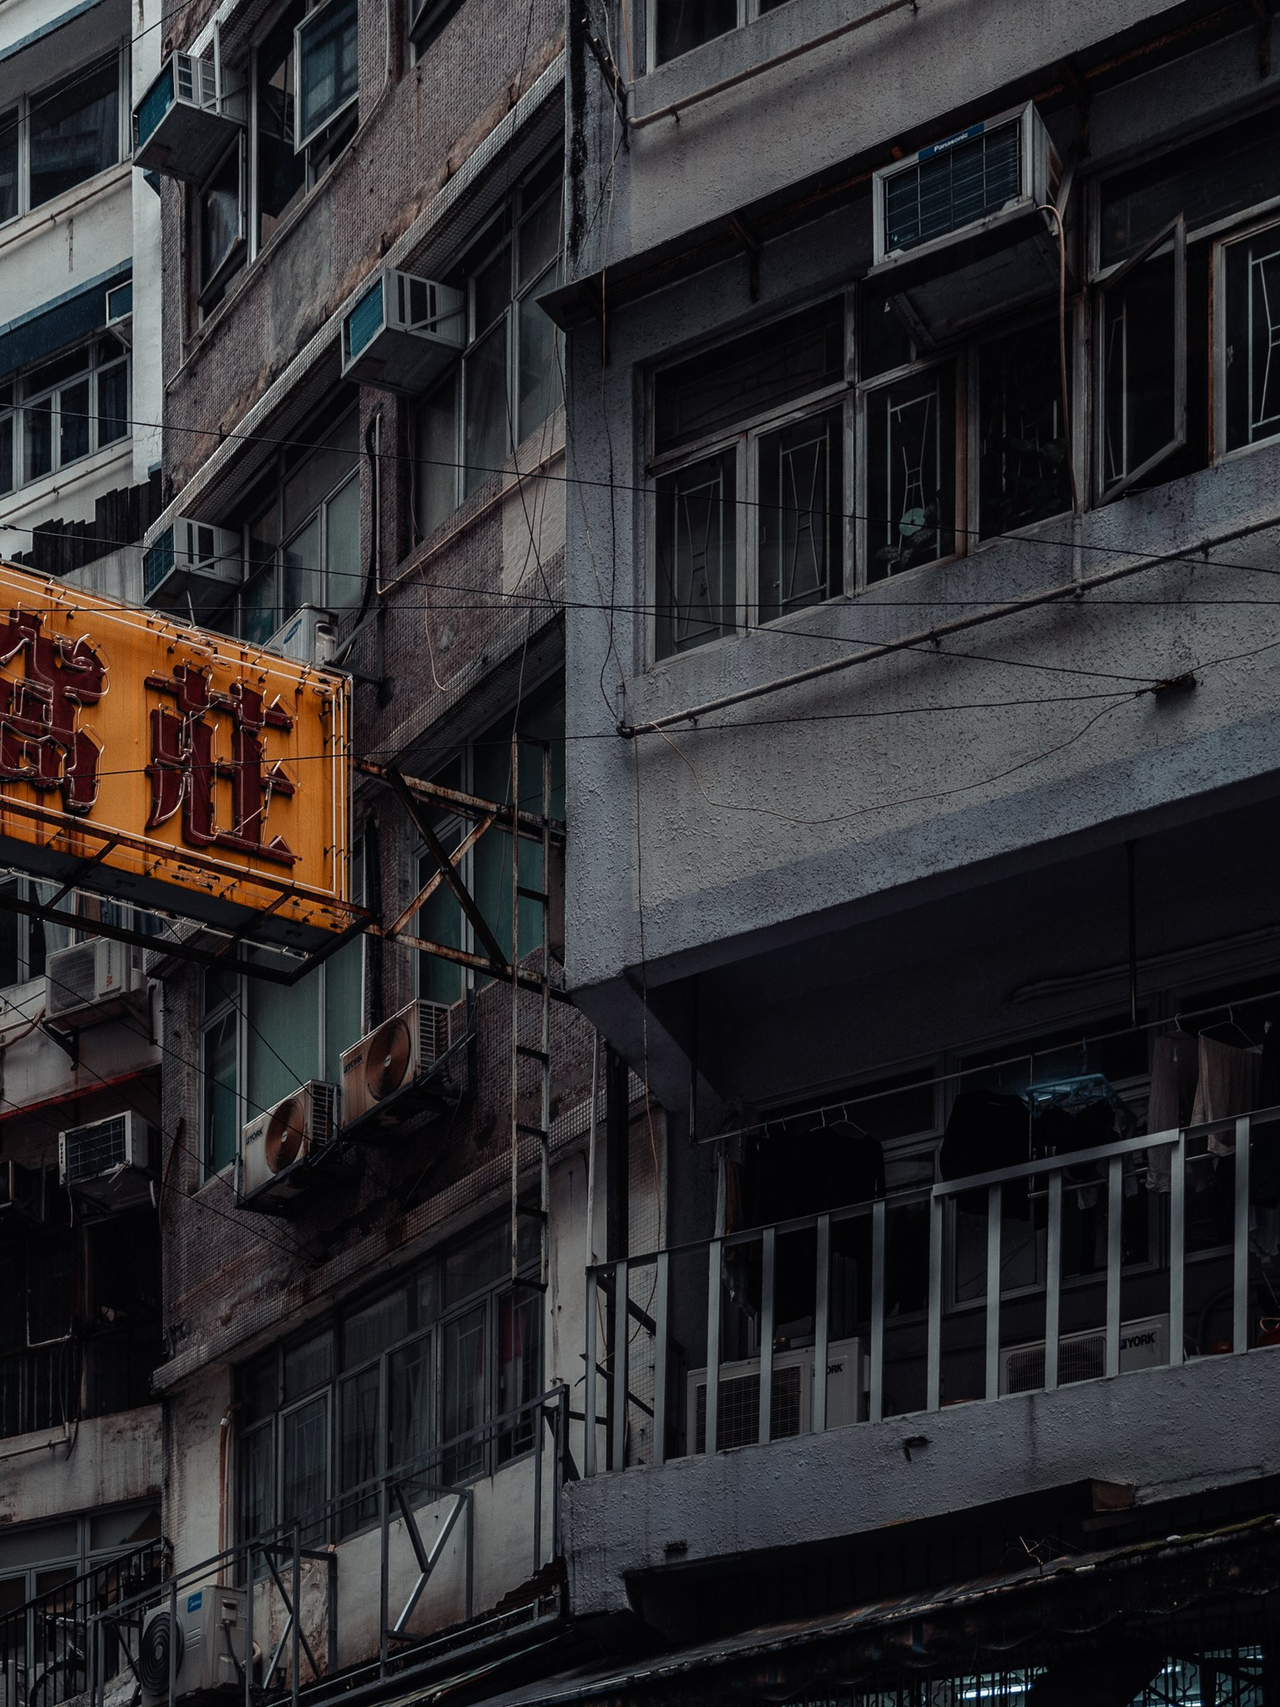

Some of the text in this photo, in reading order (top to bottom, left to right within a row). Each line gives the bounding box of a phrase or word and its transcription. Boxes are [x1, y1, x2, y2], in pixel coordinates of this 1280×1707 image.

[933, 132, 969, 153] Panasonic
[1127, 1332, 1157, 1348] YORK
[826, 1363, 844, 1375] ORK
